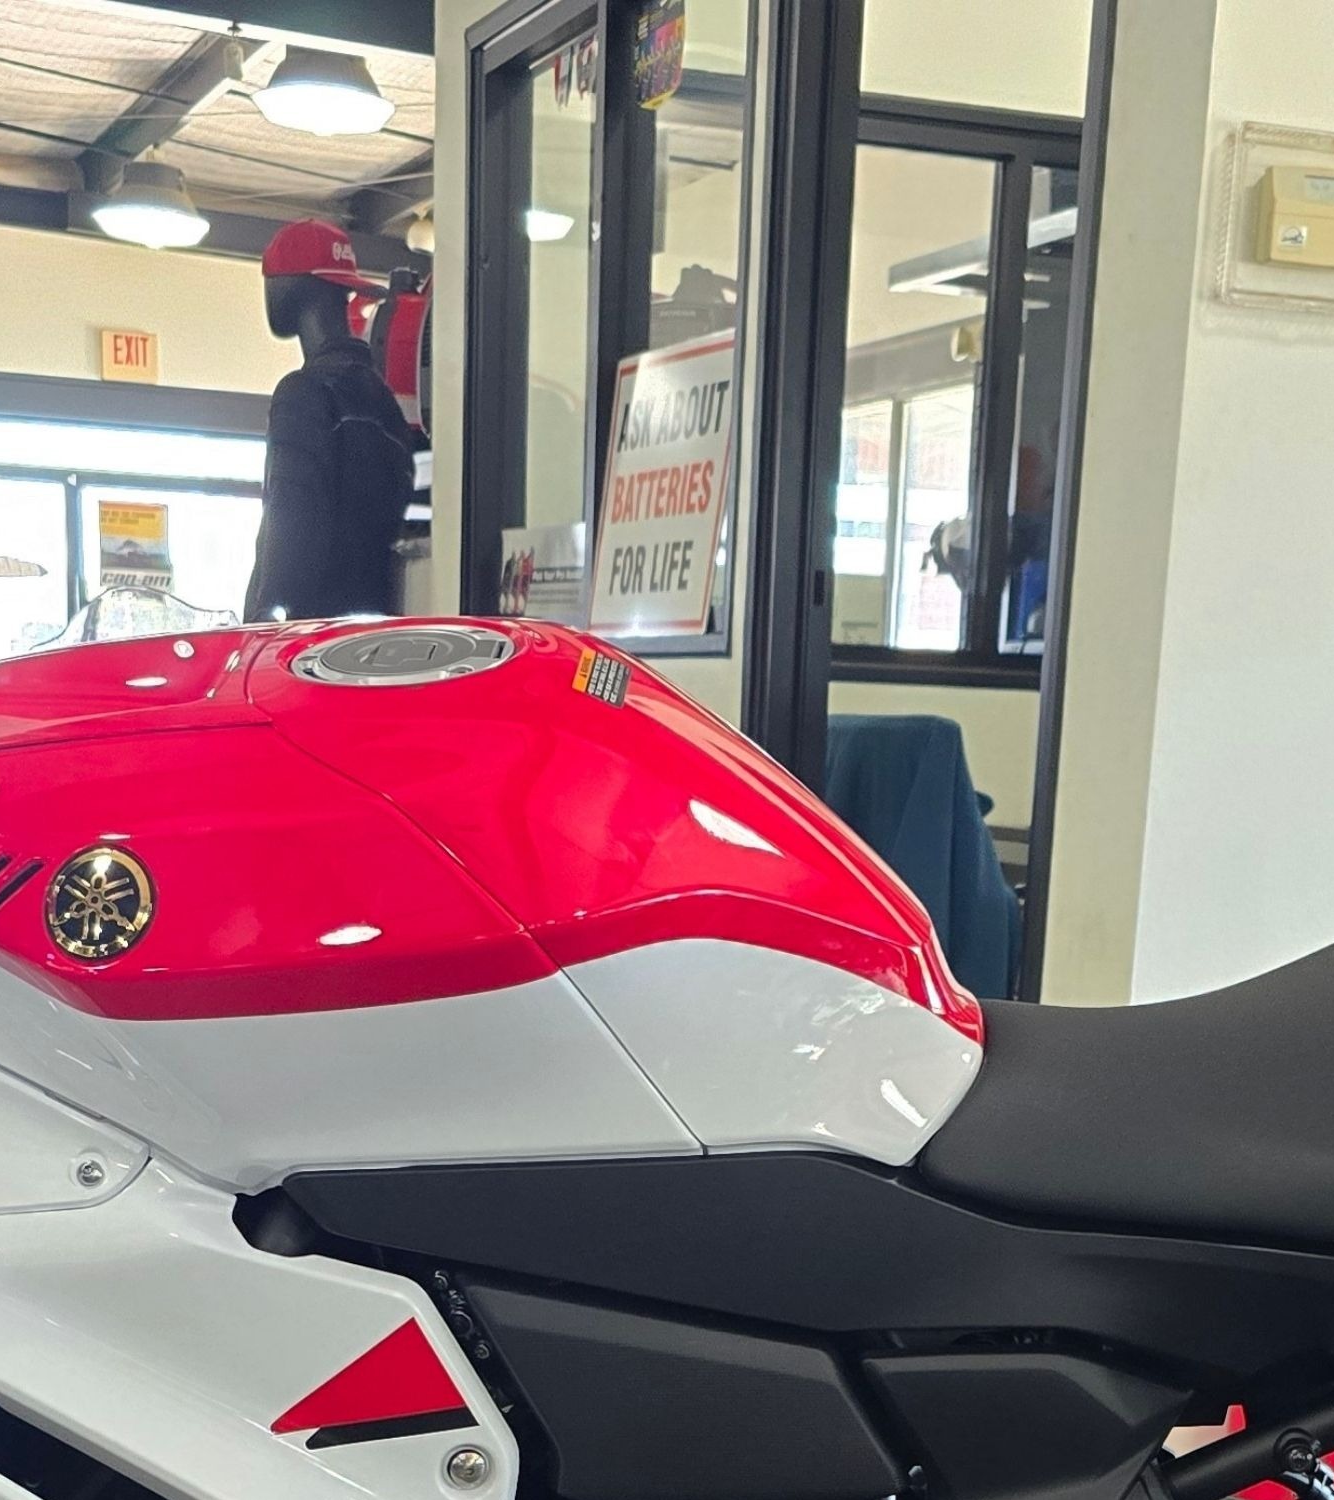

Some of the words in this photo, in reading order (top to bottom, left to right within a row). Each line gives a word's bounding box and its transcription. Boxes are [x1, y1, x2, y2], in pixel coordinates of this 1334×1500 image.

[113, 334, 150, 368] EXIT
[616, 401, 654, 453] ASK
[655, 379, 730, 446] ABOUT
[611, 459, 715, 525] BATTERIES
[609, 545, 646, 596] FOR
[649, 540, 694, 593] LIFE
